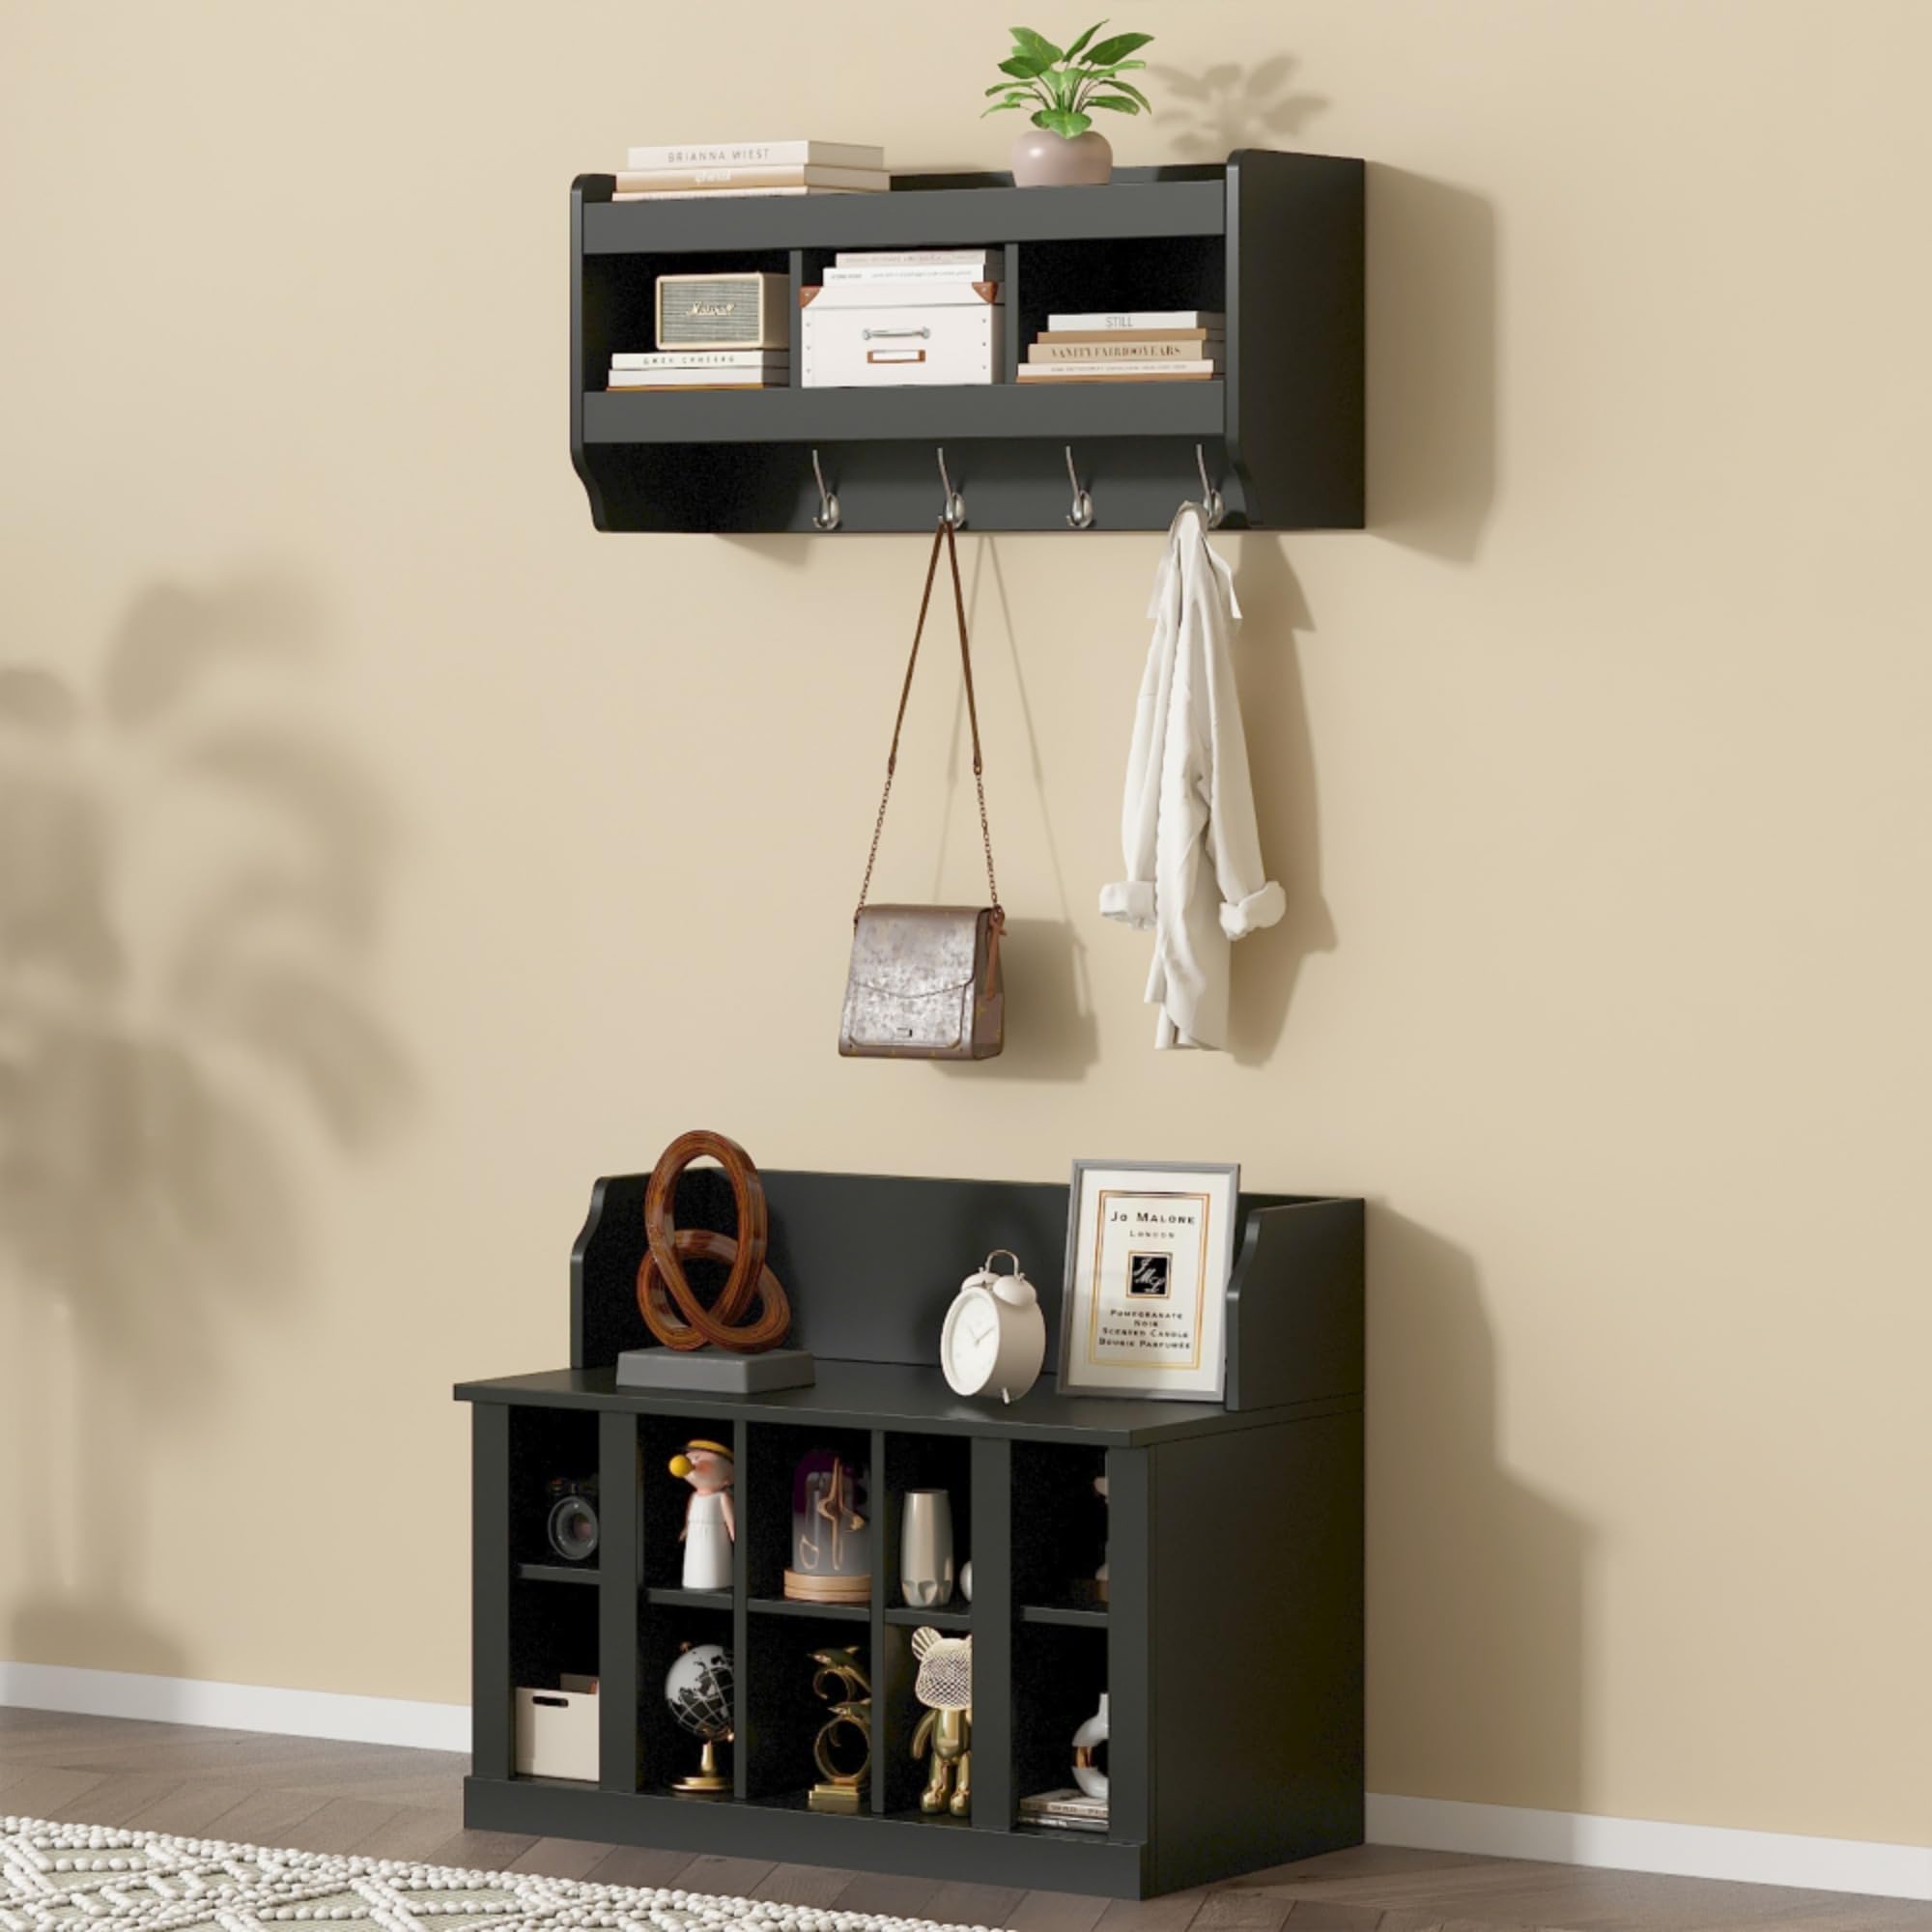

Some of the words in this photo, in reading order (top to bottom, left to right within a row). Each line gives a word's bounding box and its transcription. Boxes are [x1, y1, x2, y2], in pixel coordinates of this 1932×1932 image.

[668, 149, 726, 163] BRIANNA
[731, 147, 770, 160] WIEST
[1105, 316, 1133, 328] STILL
[1051, 347, 1092, 358] VANITY
